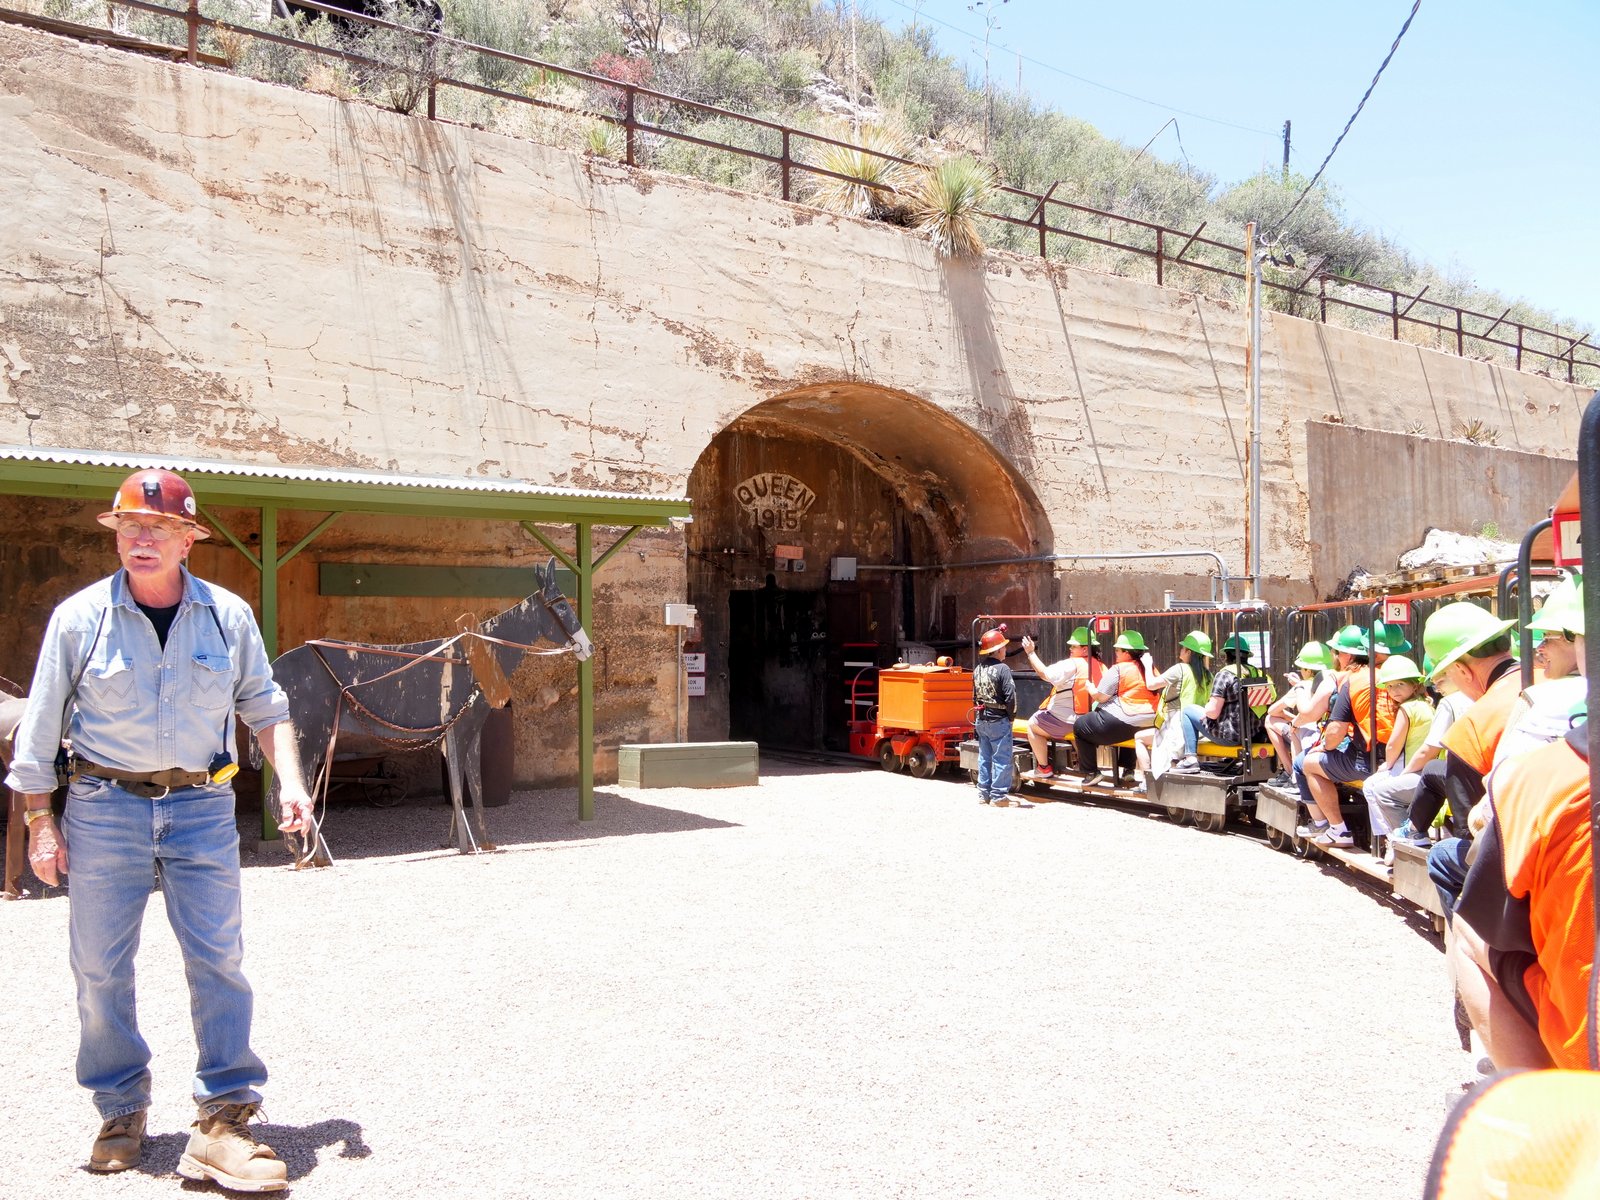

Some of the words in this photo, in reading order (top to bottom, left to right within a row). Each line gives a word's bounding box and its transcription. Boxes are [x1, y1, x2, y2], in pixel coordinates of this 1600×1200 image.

[737, 476, 814, 511] QUEEN
[753, 508, 798, 530] 1915
[1394, 607, 1401, 617] 3
